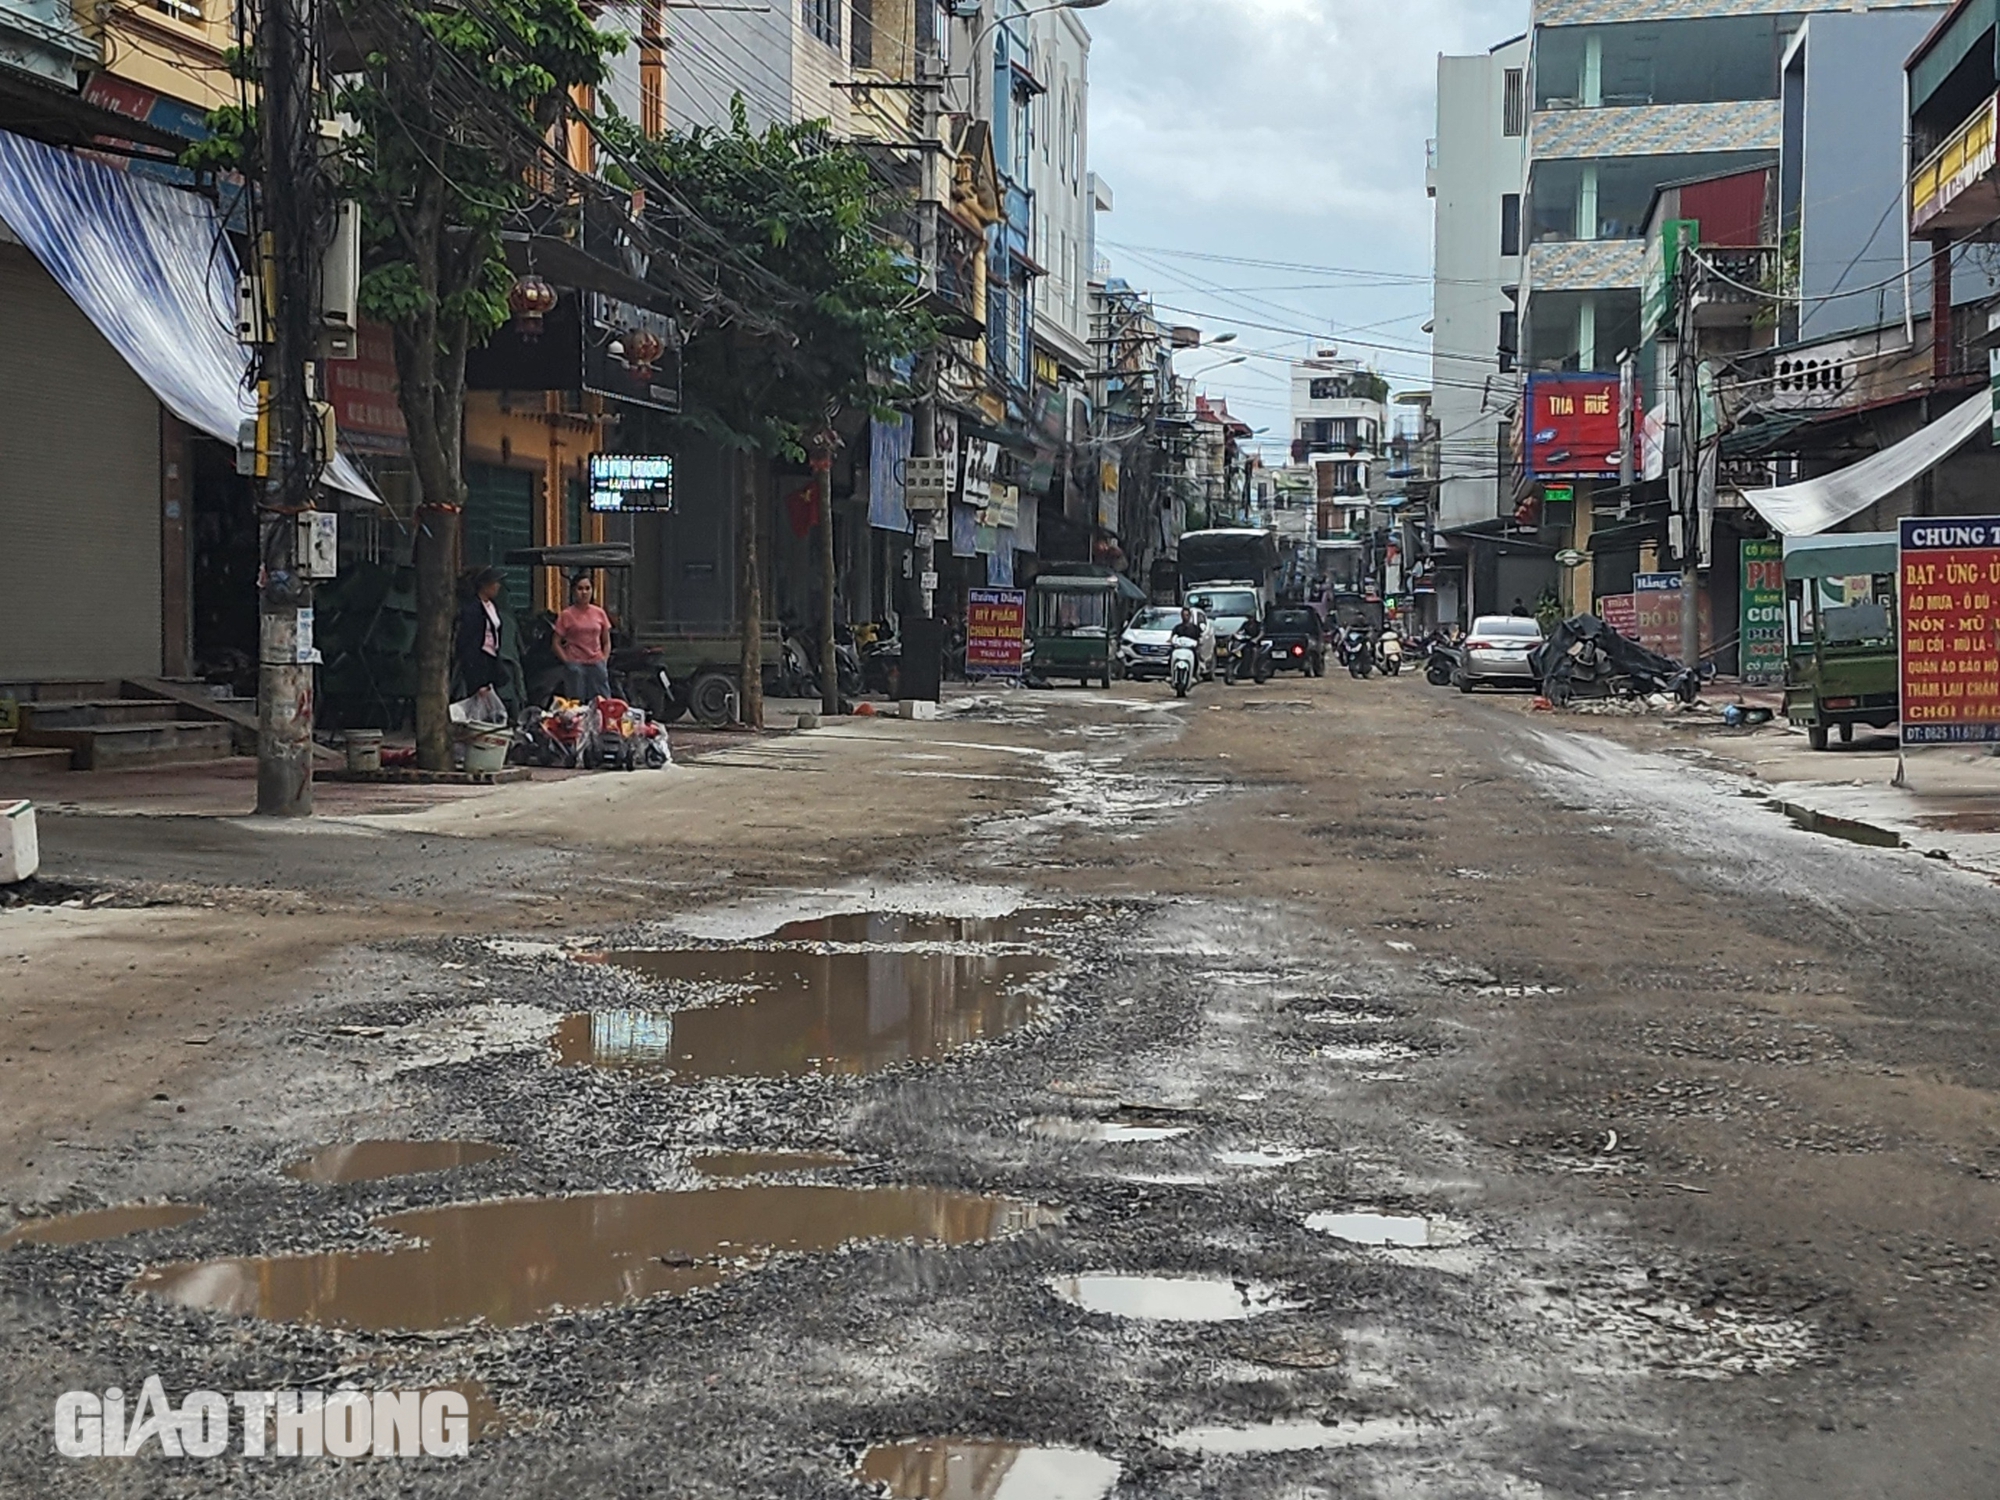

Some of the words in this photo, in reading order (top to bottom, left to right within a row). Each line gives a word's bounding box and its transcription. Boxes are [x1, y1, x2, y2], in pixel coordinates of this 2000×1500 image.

[1912, 527, 1986, 546] CHUNG
[1906, 565, 1935, 590] BẠT
[1946, 555, 1979, 584] ỦNG
[1907, 615, 1945, 632] NÓN
[1959, 614, 1985, 632] MŨ
[1943, 682, 1963, 697] LAU
